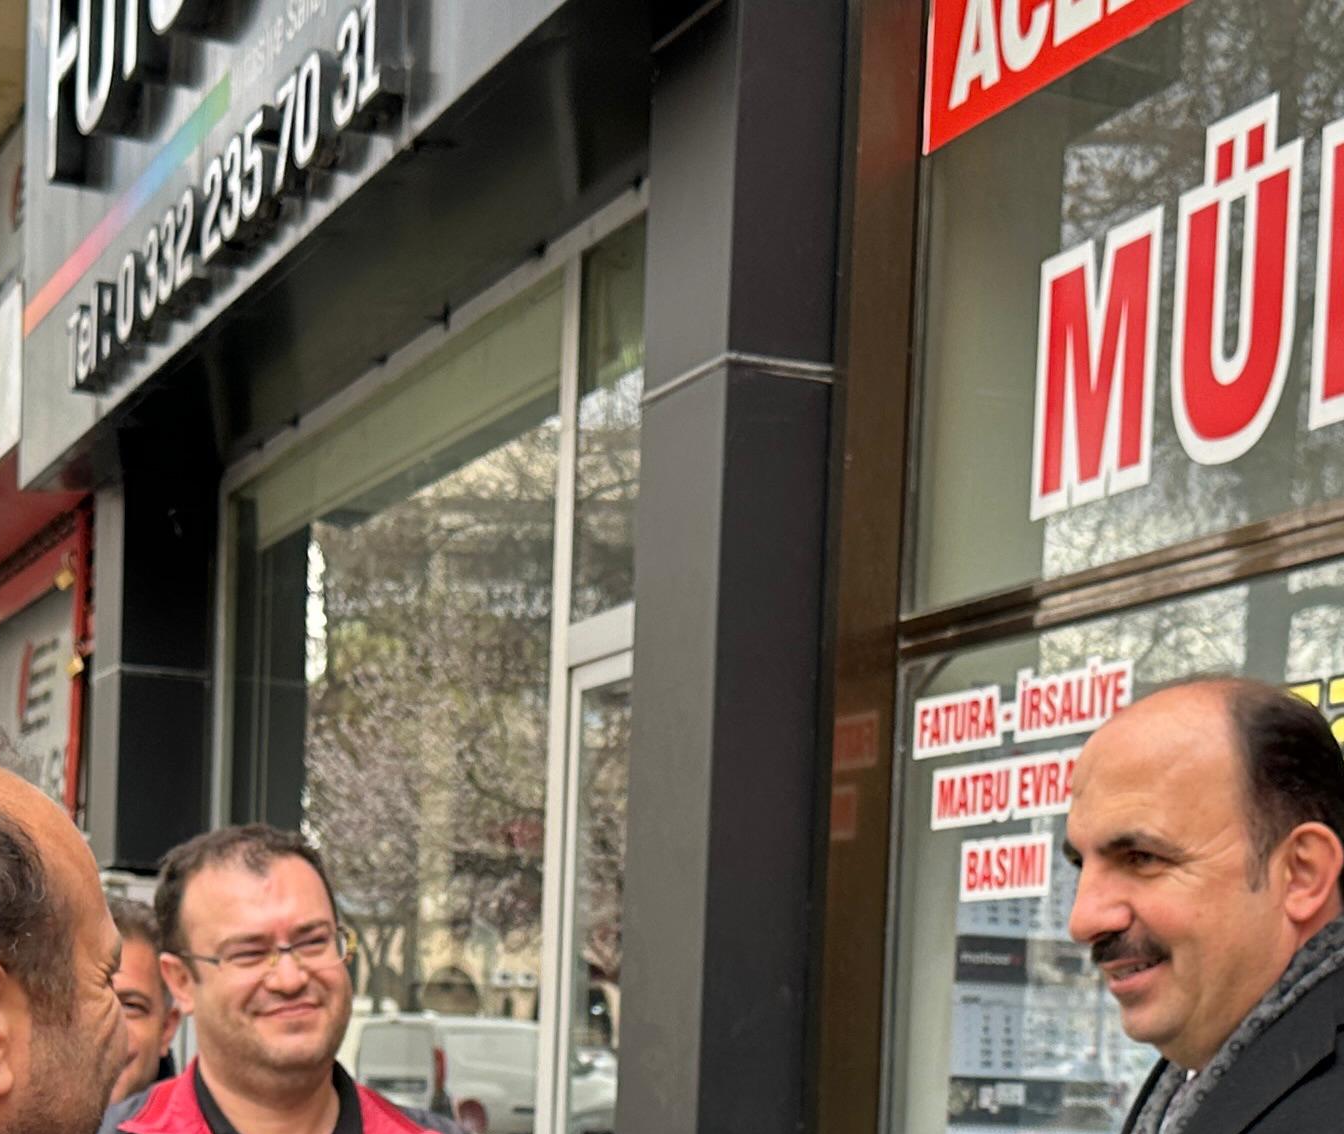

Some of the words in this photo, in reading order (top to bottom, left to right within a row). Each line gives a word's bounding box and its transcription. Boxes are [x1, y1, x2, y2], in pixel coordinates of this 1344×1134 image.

[140, 188, 194, 321] 332
[200, 108, 264, 264] 235
[273, 50, 321, 196] 70
[332, 0, 380, 128] 31
[918, 695, 997, 750] FATURA
[1019, 663, 1128, 732] İRSALİYE
[936, 768, 1012, 819] MATBU
[965, 843, 1048, 892] BASIMI
